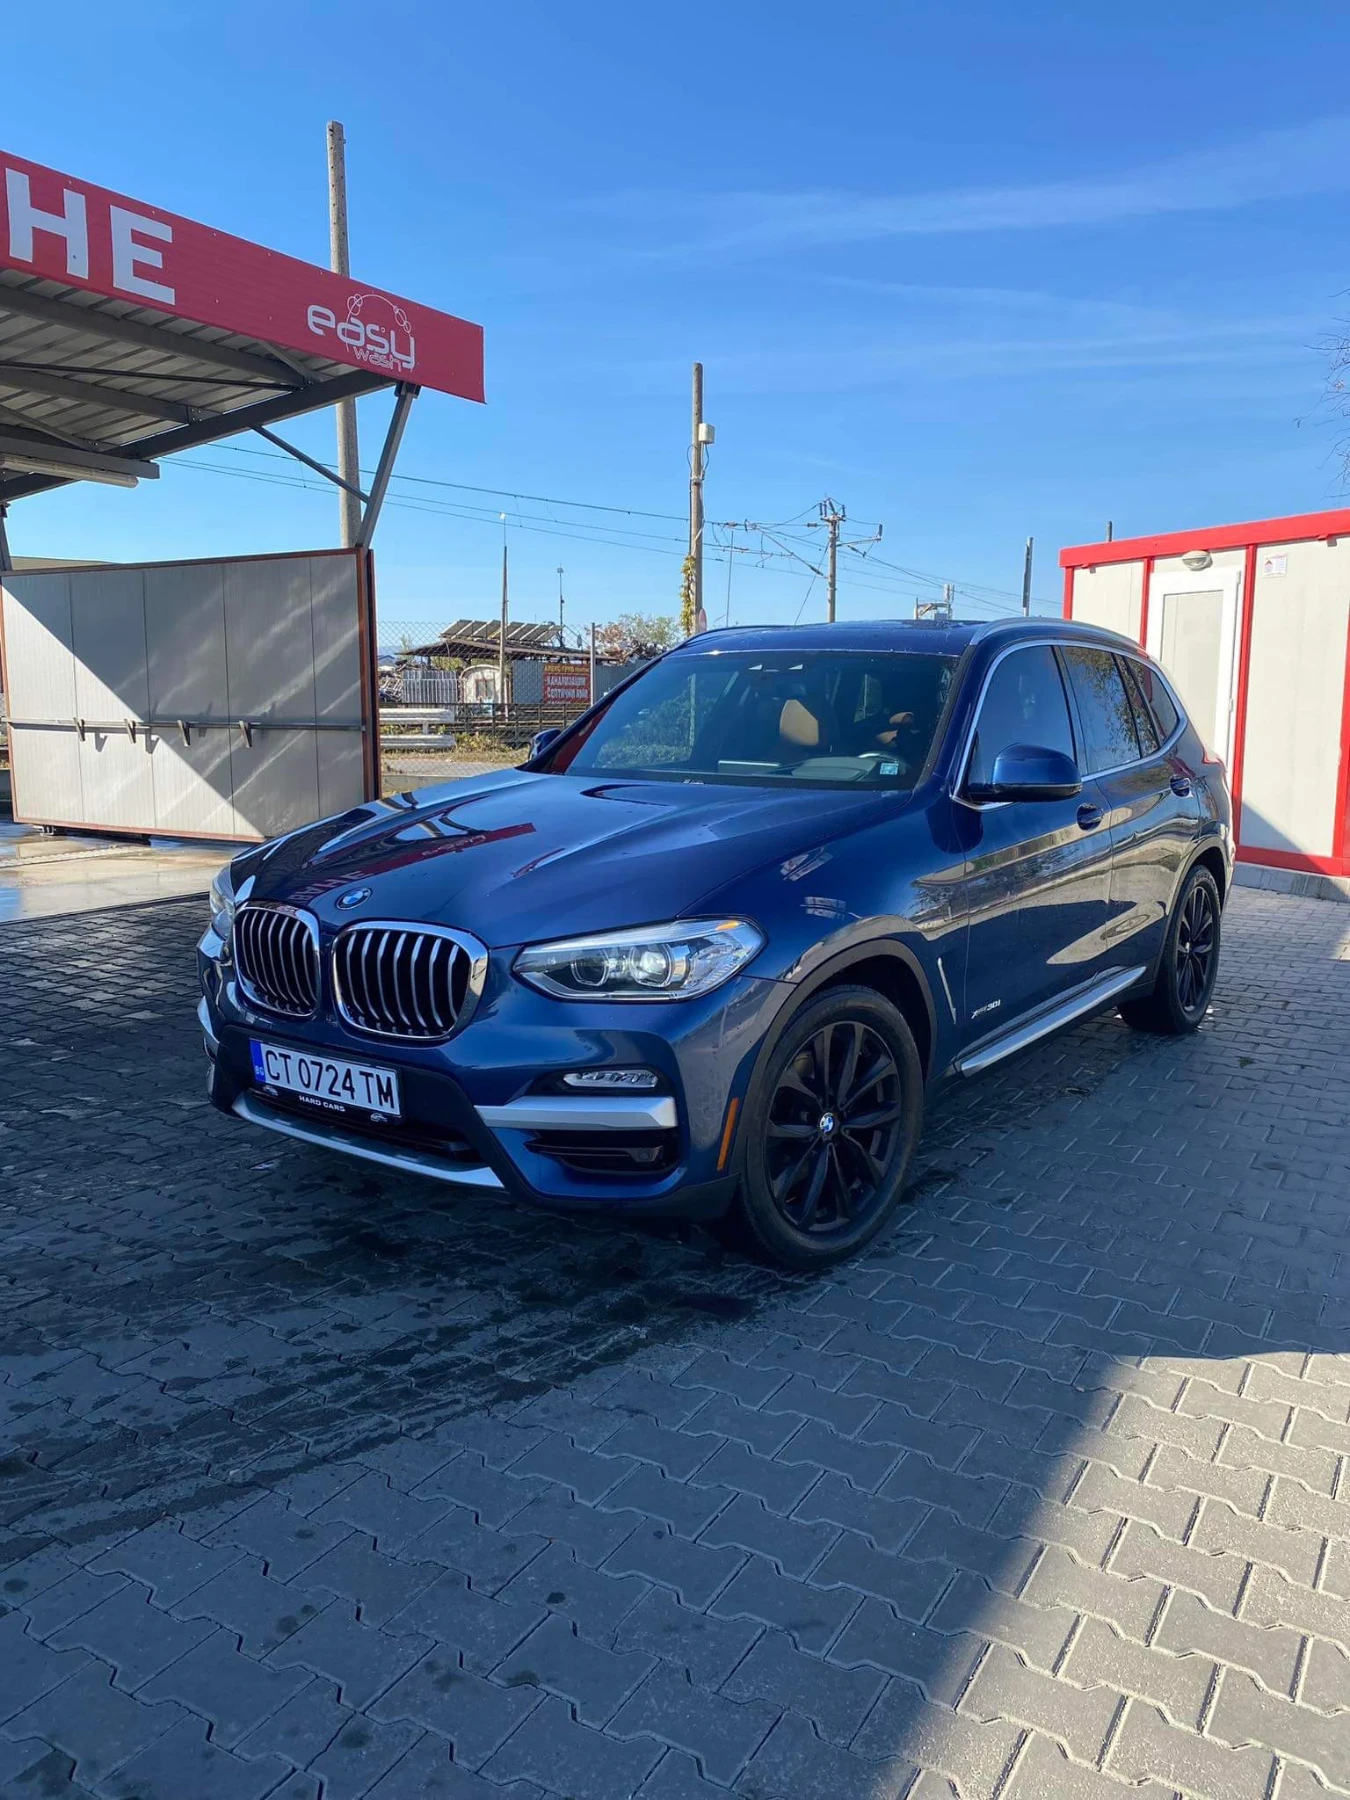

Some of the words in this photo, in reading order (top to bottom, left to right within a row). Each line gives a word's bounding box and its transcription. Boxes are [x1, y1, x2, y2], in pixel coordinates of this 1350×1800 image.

[307, 304, 415, 369] easy
[353, 346, 402, 372] wash
[265, 1050, 292, 1084] CT
[298, 1058, 355, 1100] 0724
[359, 1070, 395, 1109] TM
[298, 1095, 322, 1106] HARD
[322, 1101, 346, 1112] CARS
